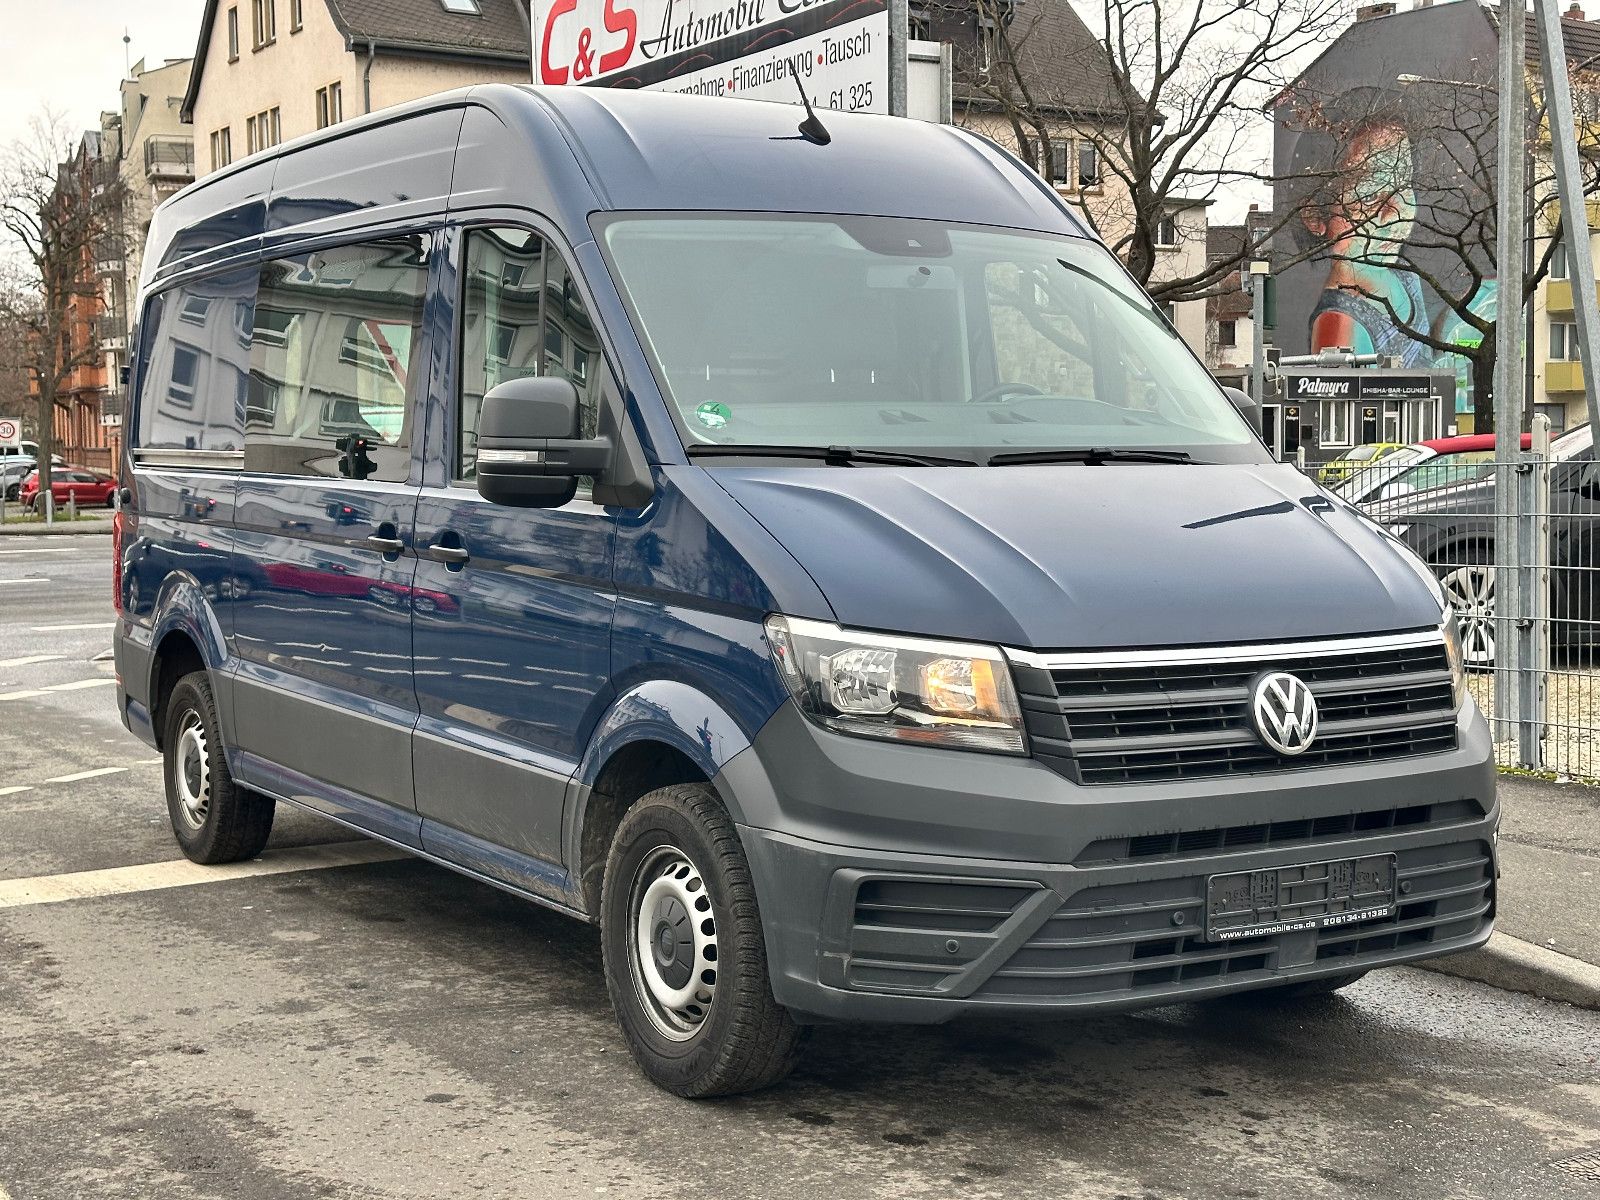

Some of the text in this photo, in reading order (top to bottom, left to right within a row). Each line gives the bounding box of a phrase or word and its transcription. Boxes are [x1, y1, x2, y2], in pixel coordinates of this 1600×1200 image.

[732, 49, 813, 93] Finanzierung
[822, 27, 871, 66] Tausch
[849, 81, 873, 110] 325
[1298, 377, 1350, 397] Palmyra
[1, 426, 12, 435] 30
